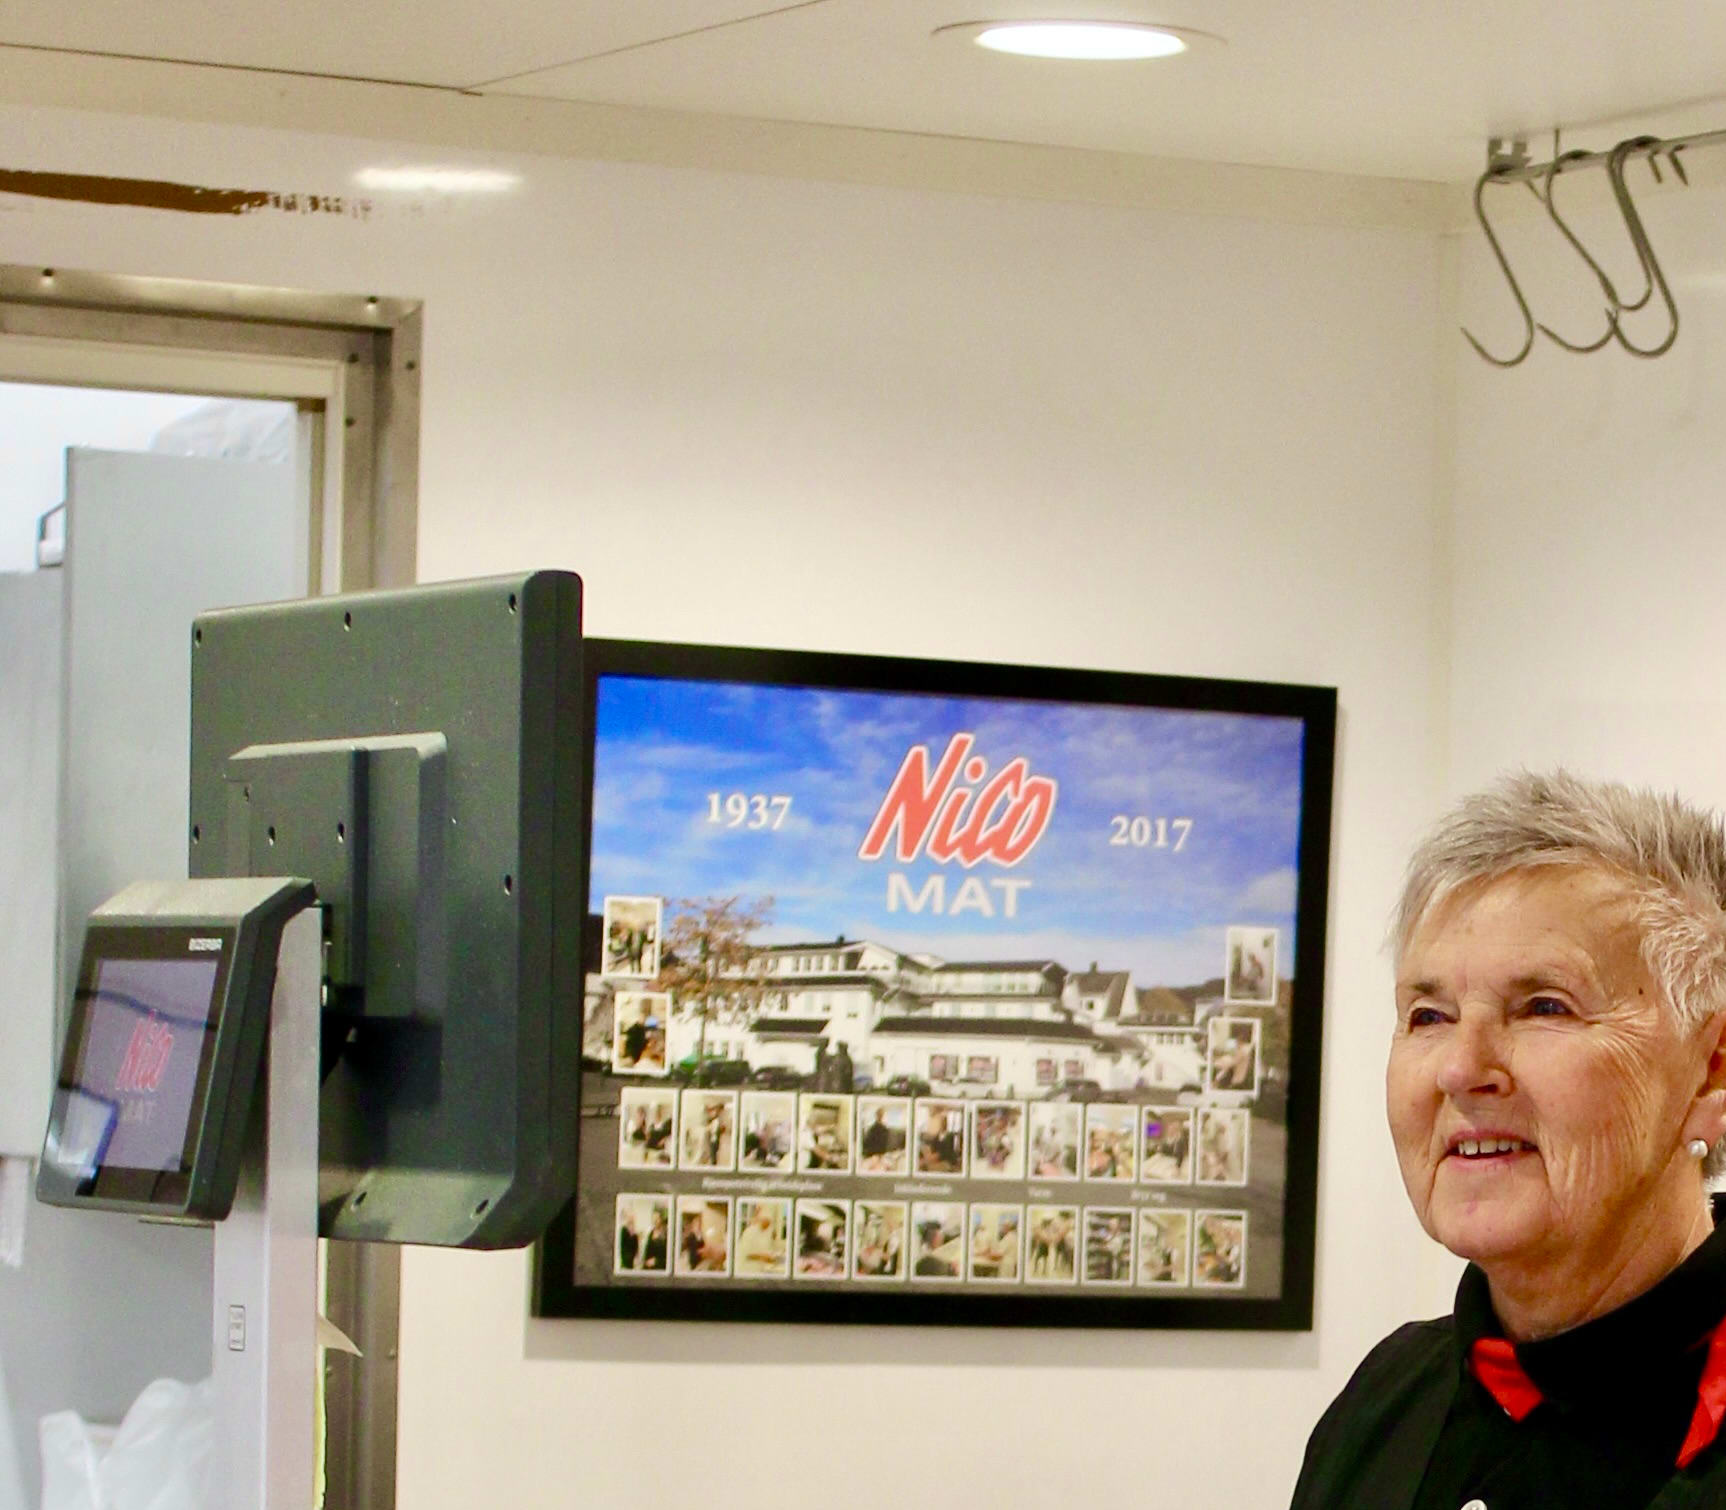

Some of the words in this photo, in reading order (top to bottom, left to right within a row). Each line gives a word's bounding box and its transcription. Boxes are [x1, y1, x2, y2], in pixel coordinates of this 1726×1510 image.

[706, 792, 793, 832] 1937
[857, 732, 1058, 869] Nico
[1109, 815, 1194, 853] 2017
[885, 873, 1033, 918] MAT
